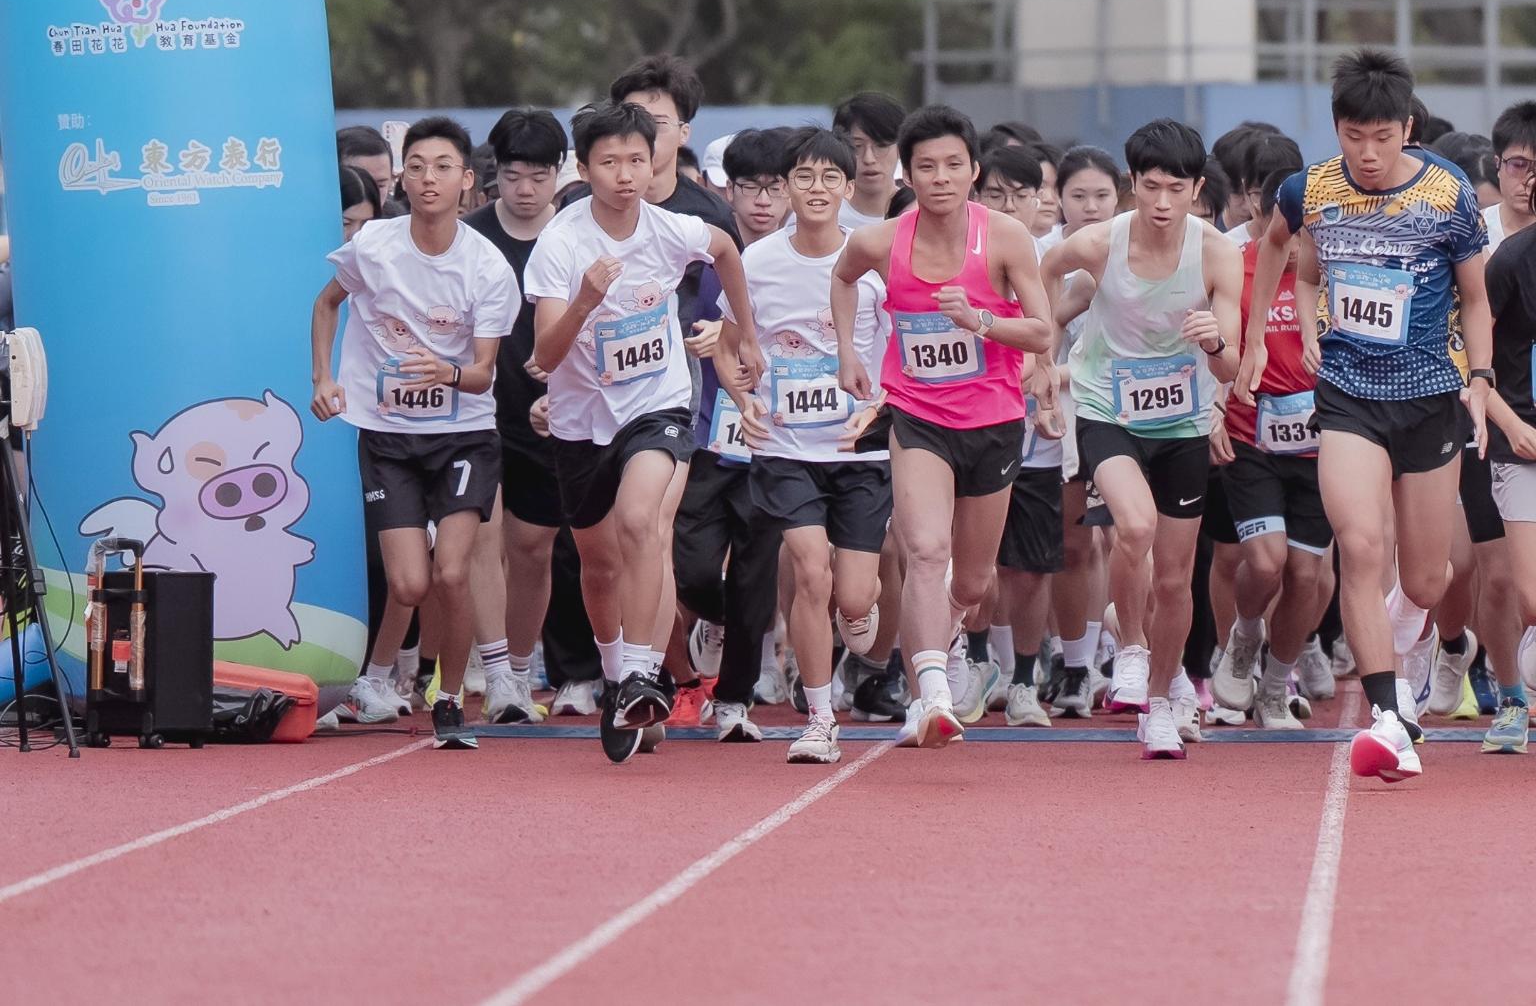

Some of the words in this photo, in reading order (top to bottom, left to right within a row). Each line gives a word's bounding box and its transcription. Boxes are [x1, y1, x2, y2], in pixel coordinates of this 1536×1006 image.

[74, 24, 98, 36] Tian
[102, 23, 123, 34] Hua
[155, 21, 177, 32] Hua
[180, 19, 243, 31] Foundation
[52, 37, 126, 54] 春田花花
[159, 32, 239, 48] 教育基金
[1267, 305, 1298, 322] KS
[1340, 296, 1393, 329] 1445
[1265, 325, 1279, 333] AIL
[613, 338, 664, 371] 1443
[911, 341, 969, 368] 1340
[391, 387, 444, 409] 1446
[785, 387, 839, 414] 1444
[1129, 383, 1184, 411] 1295
[453, 459, 472, 496] 7
